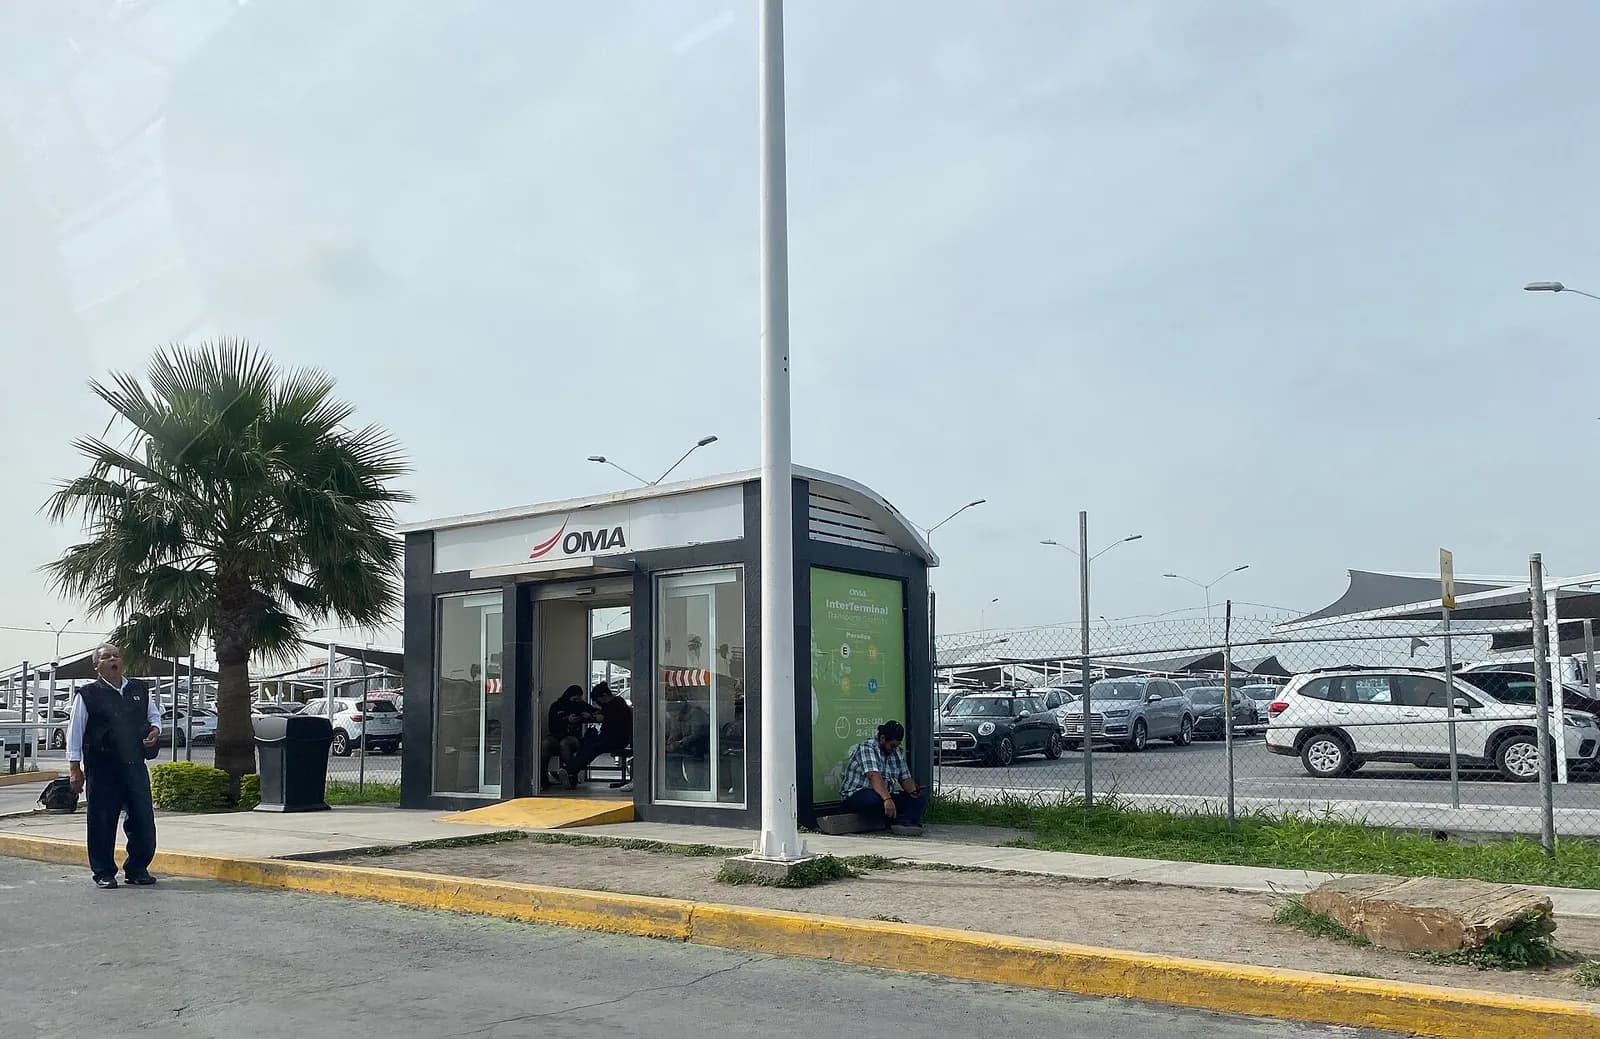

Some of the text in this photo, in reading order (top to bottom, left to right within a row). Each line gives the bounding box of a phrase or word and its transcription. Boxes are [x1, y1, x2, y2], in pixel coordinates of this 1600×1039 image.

[562, 526, 626, 555] OMA
[849, 589, 866, 597] OMA
[825, 600, 888, 615] InterTerminal
